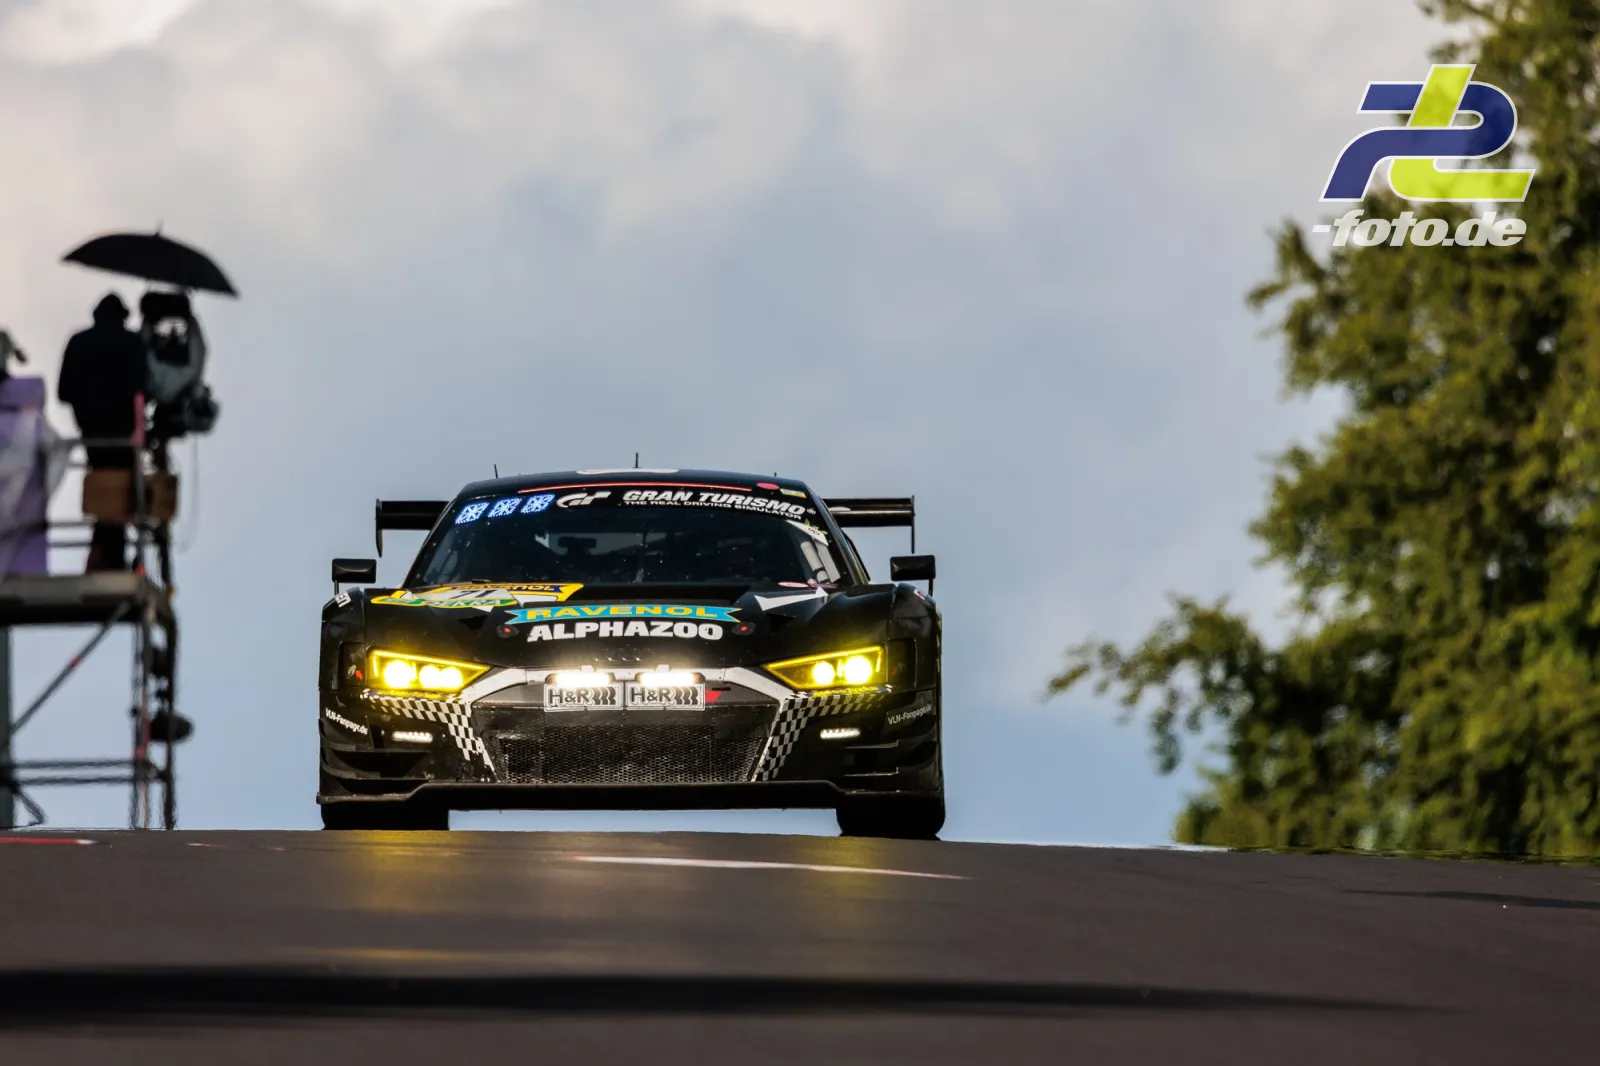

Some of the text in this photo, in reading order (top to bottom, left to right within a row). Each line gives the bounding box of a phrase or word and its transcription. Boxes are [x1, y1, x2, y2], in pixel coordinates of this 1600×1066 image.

[622, 490, 697, 502] GRAN
[699, 492, 806, 515] TURISMO
[735, 504, 802, 520] SIMULATOR
[526, 606, 718, 620] RAVENOL
[527, 621, 724, 642] ALPHAZOO
[549, 688, 590, 705] H&R
[631, 687, 672, 704] H&R
